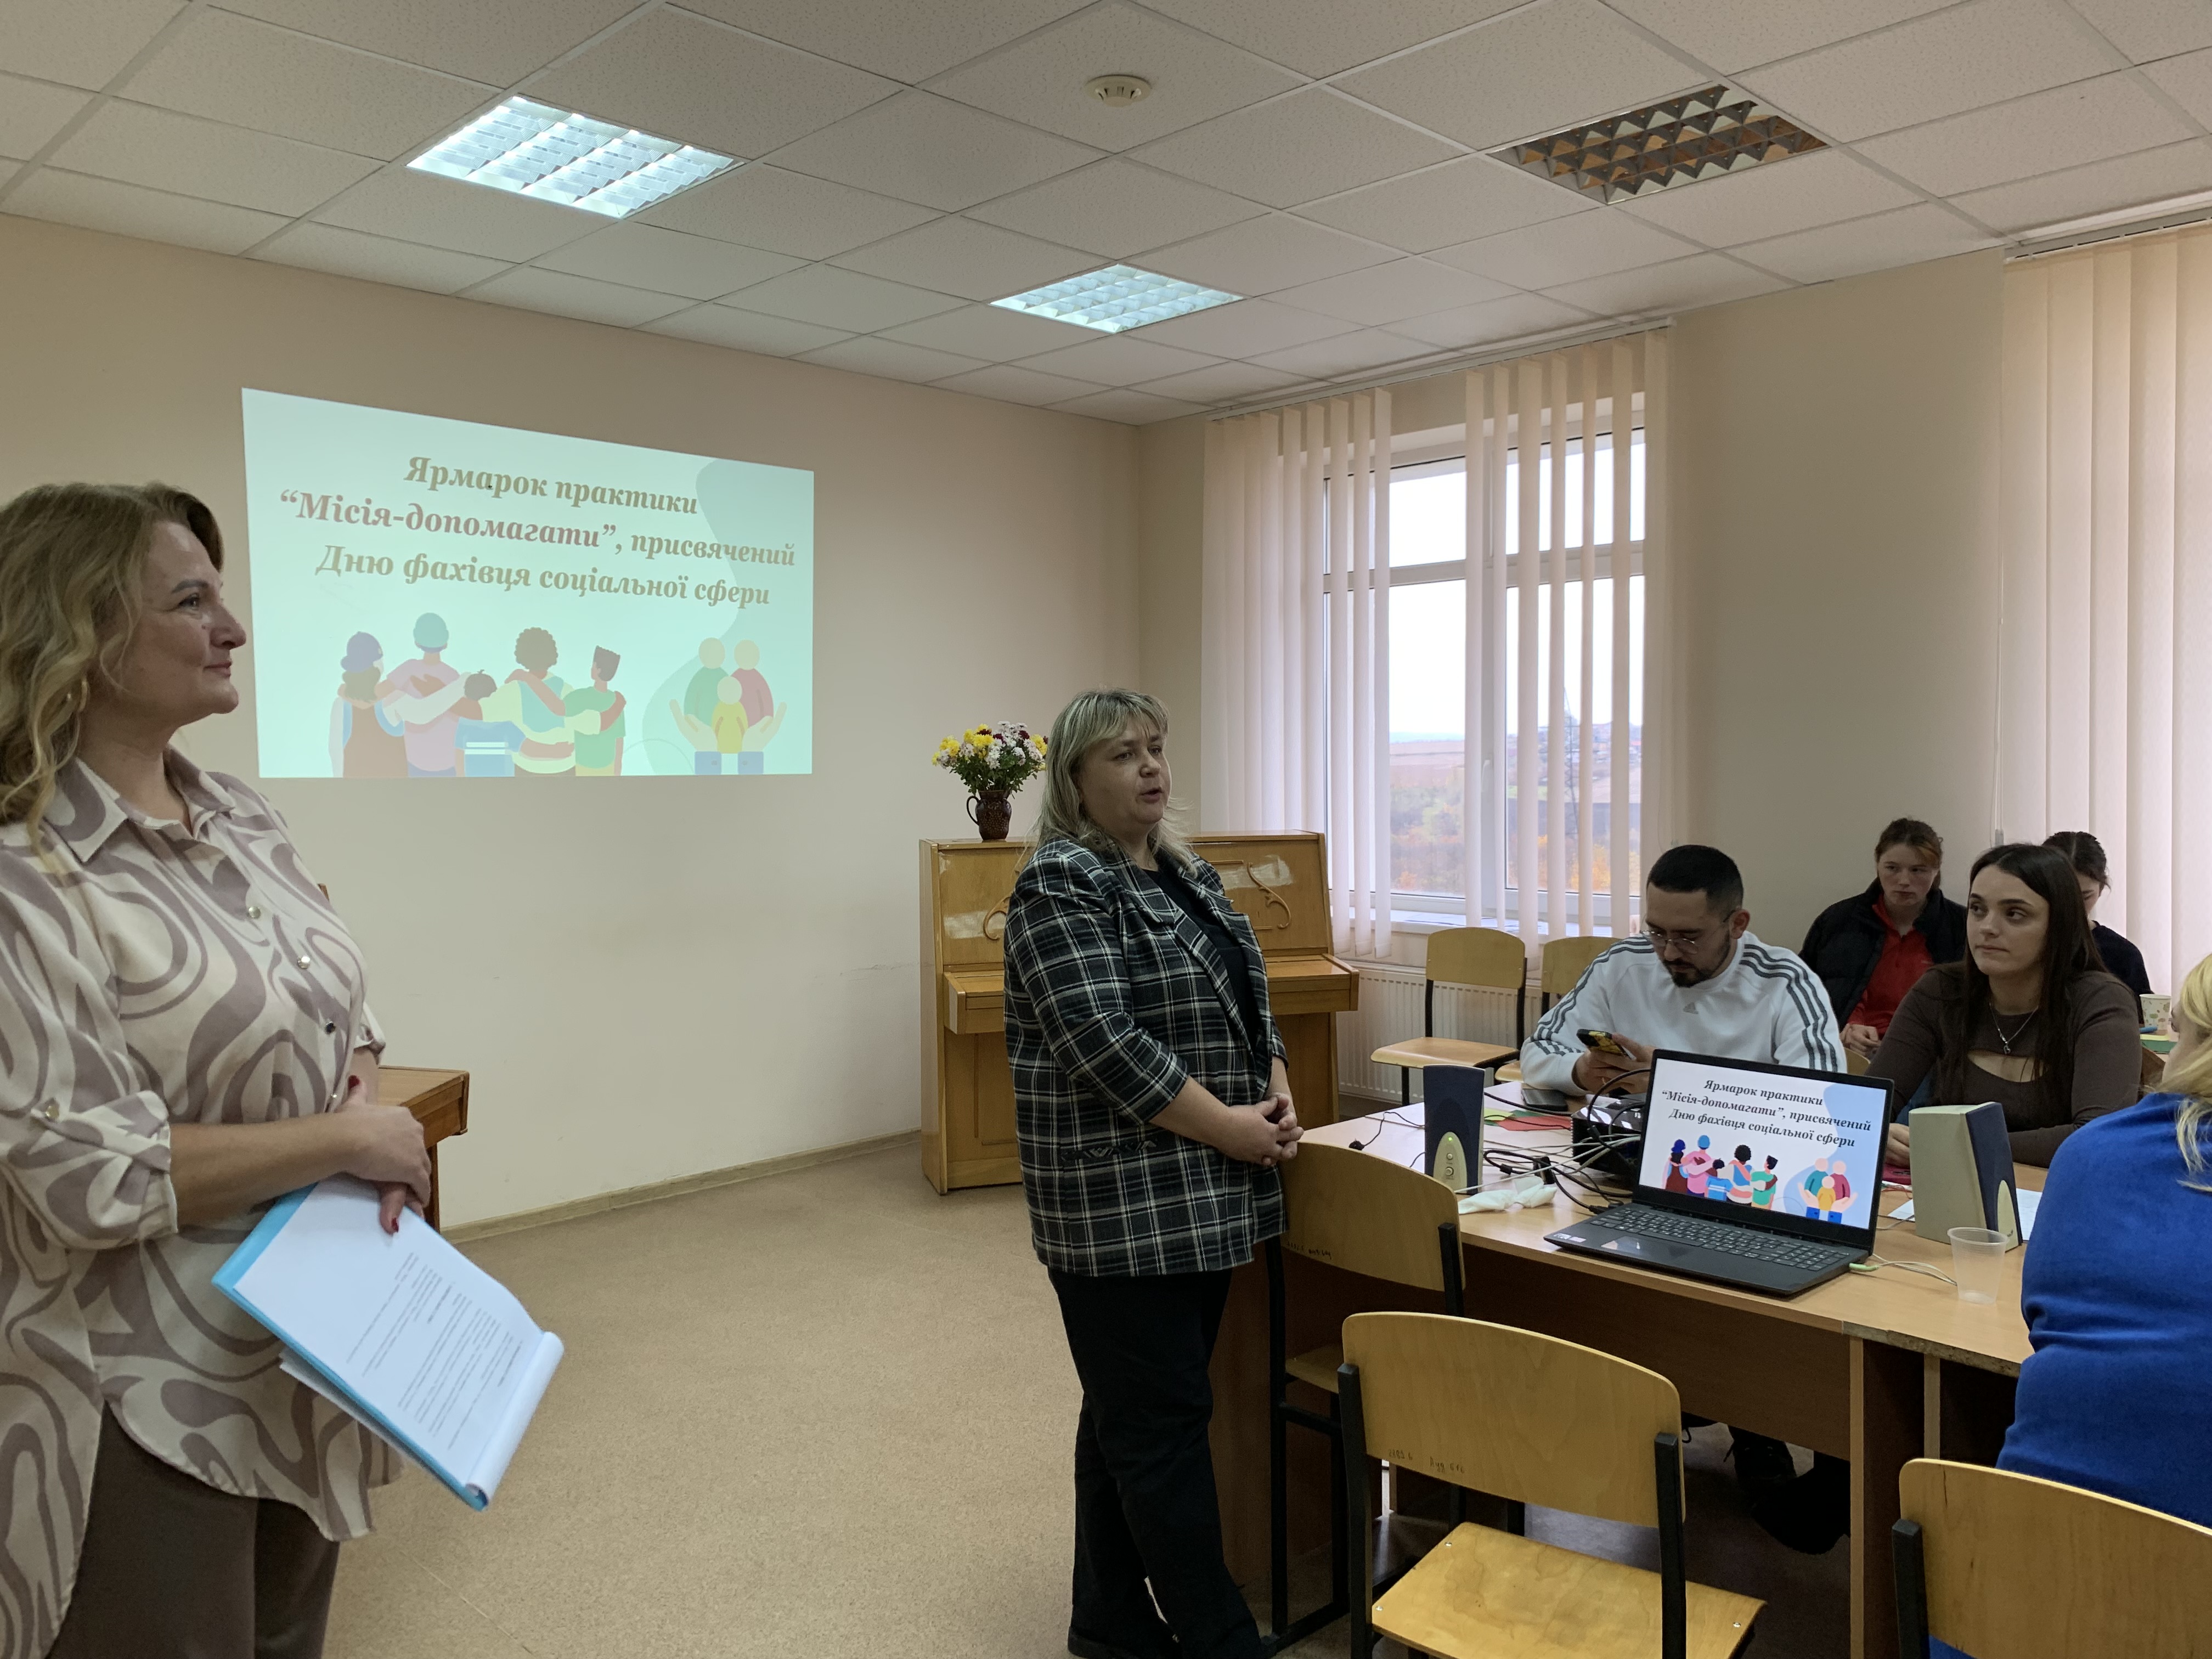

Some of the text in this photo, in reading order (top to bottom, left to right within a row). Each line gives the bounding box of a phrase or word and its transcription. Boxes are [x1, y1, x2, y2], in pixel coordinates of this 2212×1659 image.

[403, 456, 698, 514] Ярмарок практики
[631, 534, 795, 566] присвячений
[315, 545, 769, 608] Дню фахівця соціальної сфери
[1703, 1080, 1823, 1105] Ярмарок практики
[1668, 1108, 1855, 1147] Дню фахівця соціальної сфери
[1790, 1111, 1871, 1131] присвячений
